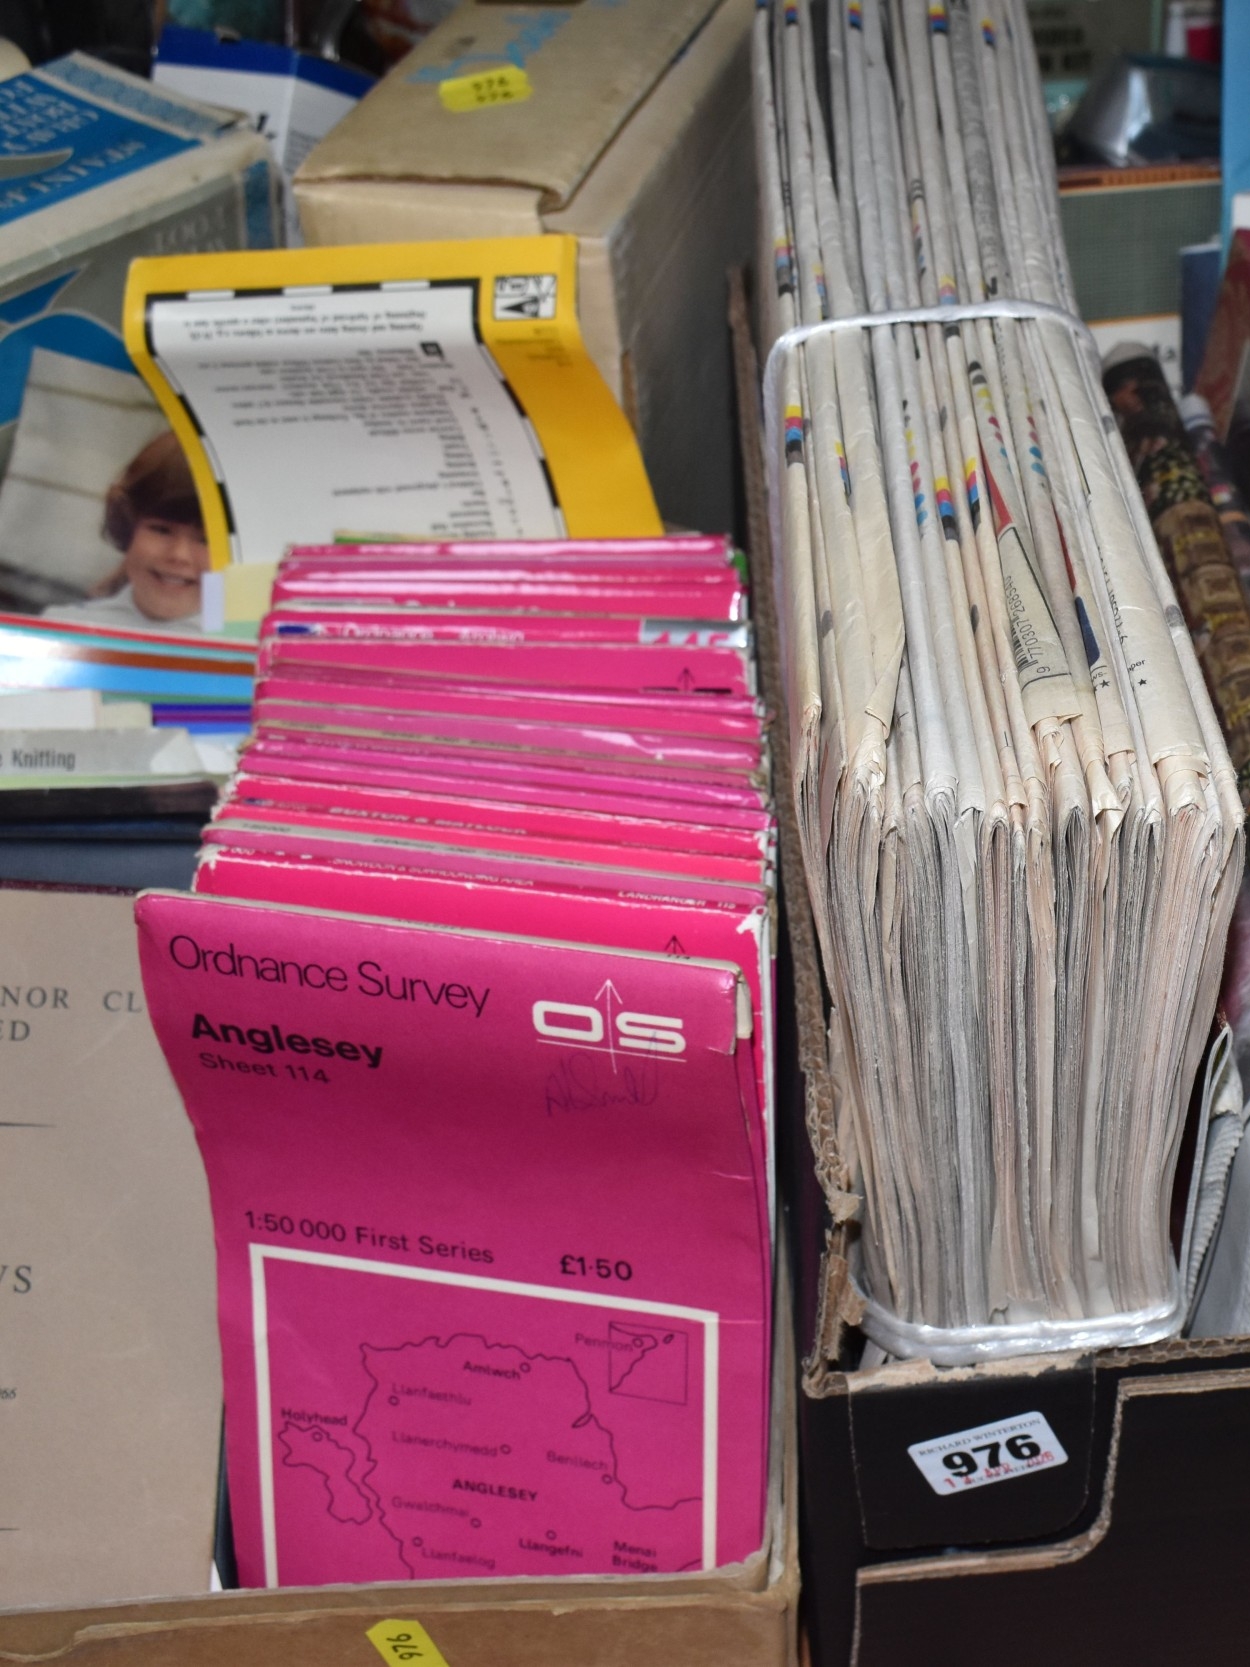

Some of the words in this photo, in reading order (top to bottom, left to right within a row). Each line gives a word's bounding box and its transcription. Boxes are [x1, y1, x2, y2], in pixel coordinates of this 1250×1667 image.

[1017, 618, 1045, 658] 770307
[11, 749, 77, 772] Knitting
[168, 934, 350, 992] Ordnance
[357, 960, 491, 1018] Survey
[532, 1000, 687, 1054] OS
[191, 1013, 383, 1069] Anglesey
[198, 1051, 278, 1078] Sheet
[286, 1065, 331, 1084] 114
[244, 1210, 295, 1236] 1:50
[299, 1217, 348, 1244] 000
[355, 1226, 410, 1252] First
[418, 1235, 496, 1264] Series
[574, 1332, 634, 1351] Penmon
[462, 1360, 521, 1380] Amlwch
[280, 1407, 348, 1426] Holyhead
[972, 1418, 1042, 1443] WINTERTON
[941, 1433, 1042, 1478] 976
[452, 1478, 538, 1502] ANGLESEY
[518, 1538, 584, 1558] Llangefni
[613, 1540, 658, 1558] Menai
[612, 1555, 659, 1573] Bridge
[385, 1632, 425, 1661] 976
